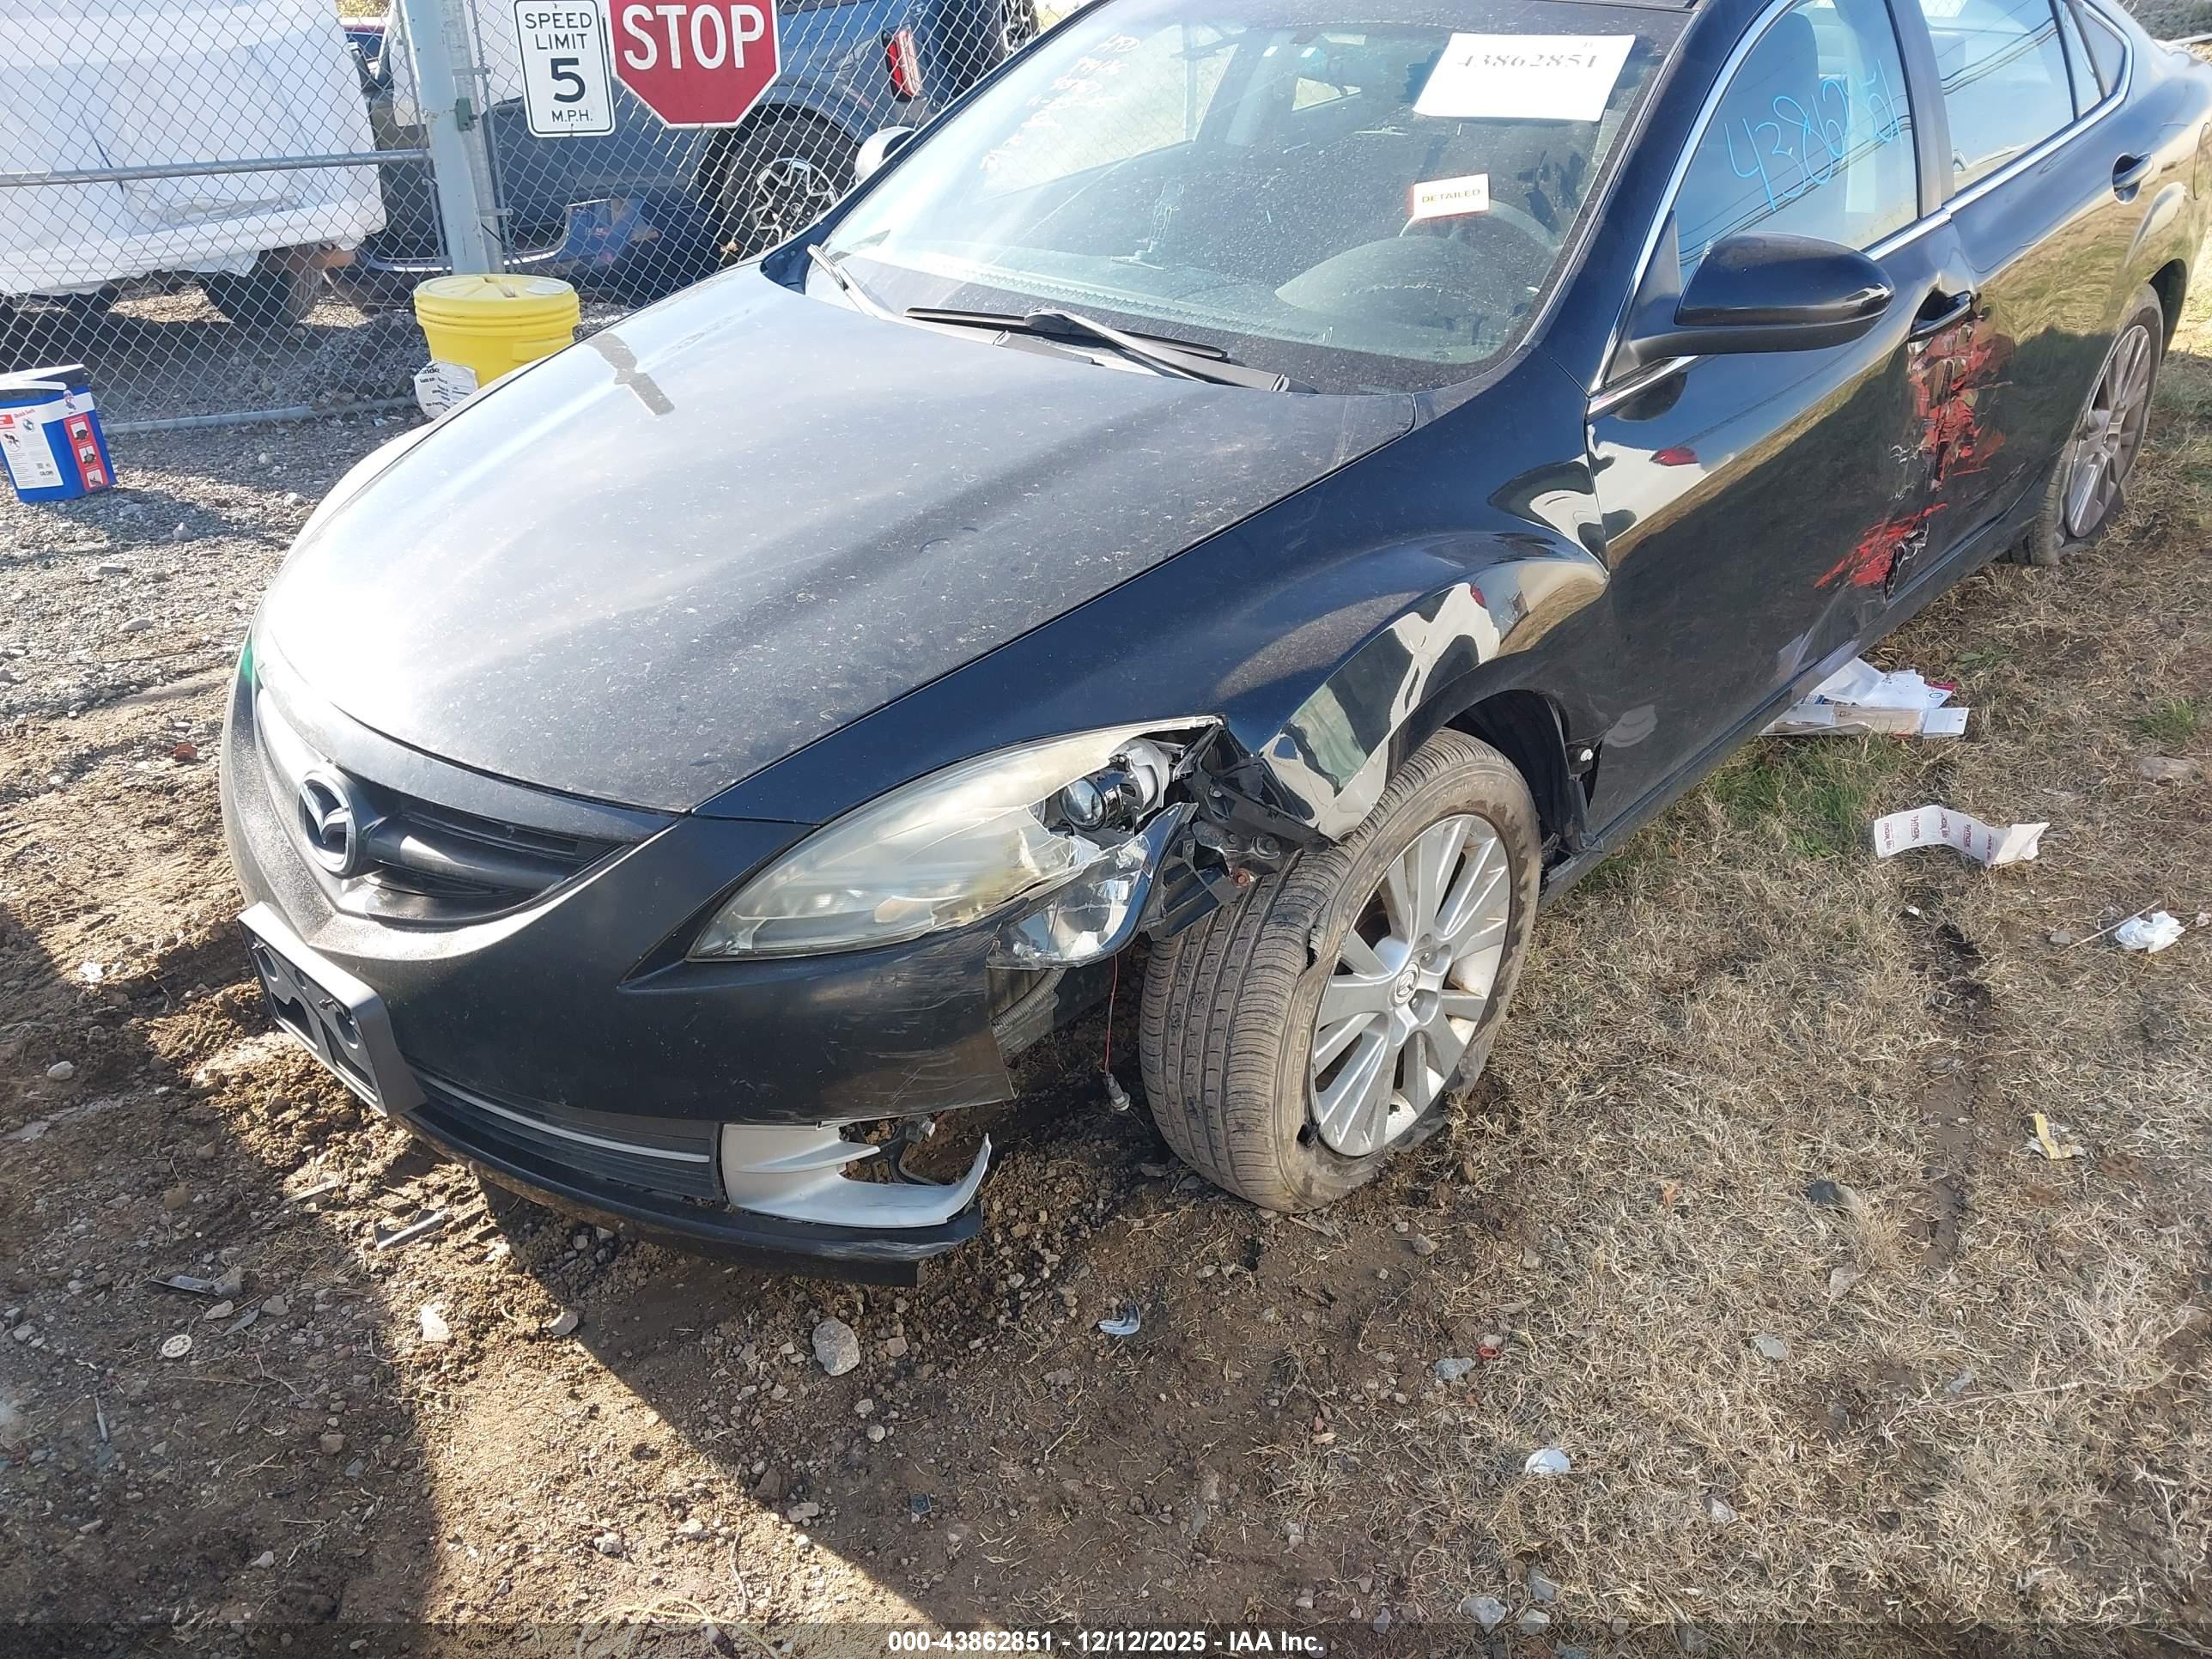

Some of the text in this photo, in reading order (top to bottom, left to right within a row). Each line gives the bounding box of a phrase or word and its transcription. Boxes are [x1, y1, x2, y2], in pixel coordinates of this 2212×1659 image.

[525, 13, 592, 29] SPEED
[534, 33, 587, 51] LIMIT
[623, 4, 765, 70] STOP
[1457, 54, 1597, 68] 43862851
[550, 58, 586, 103] 5
[551, 110, 593, 124] M.P.H.
[1421, 189, 1480, 204] DETAILED
